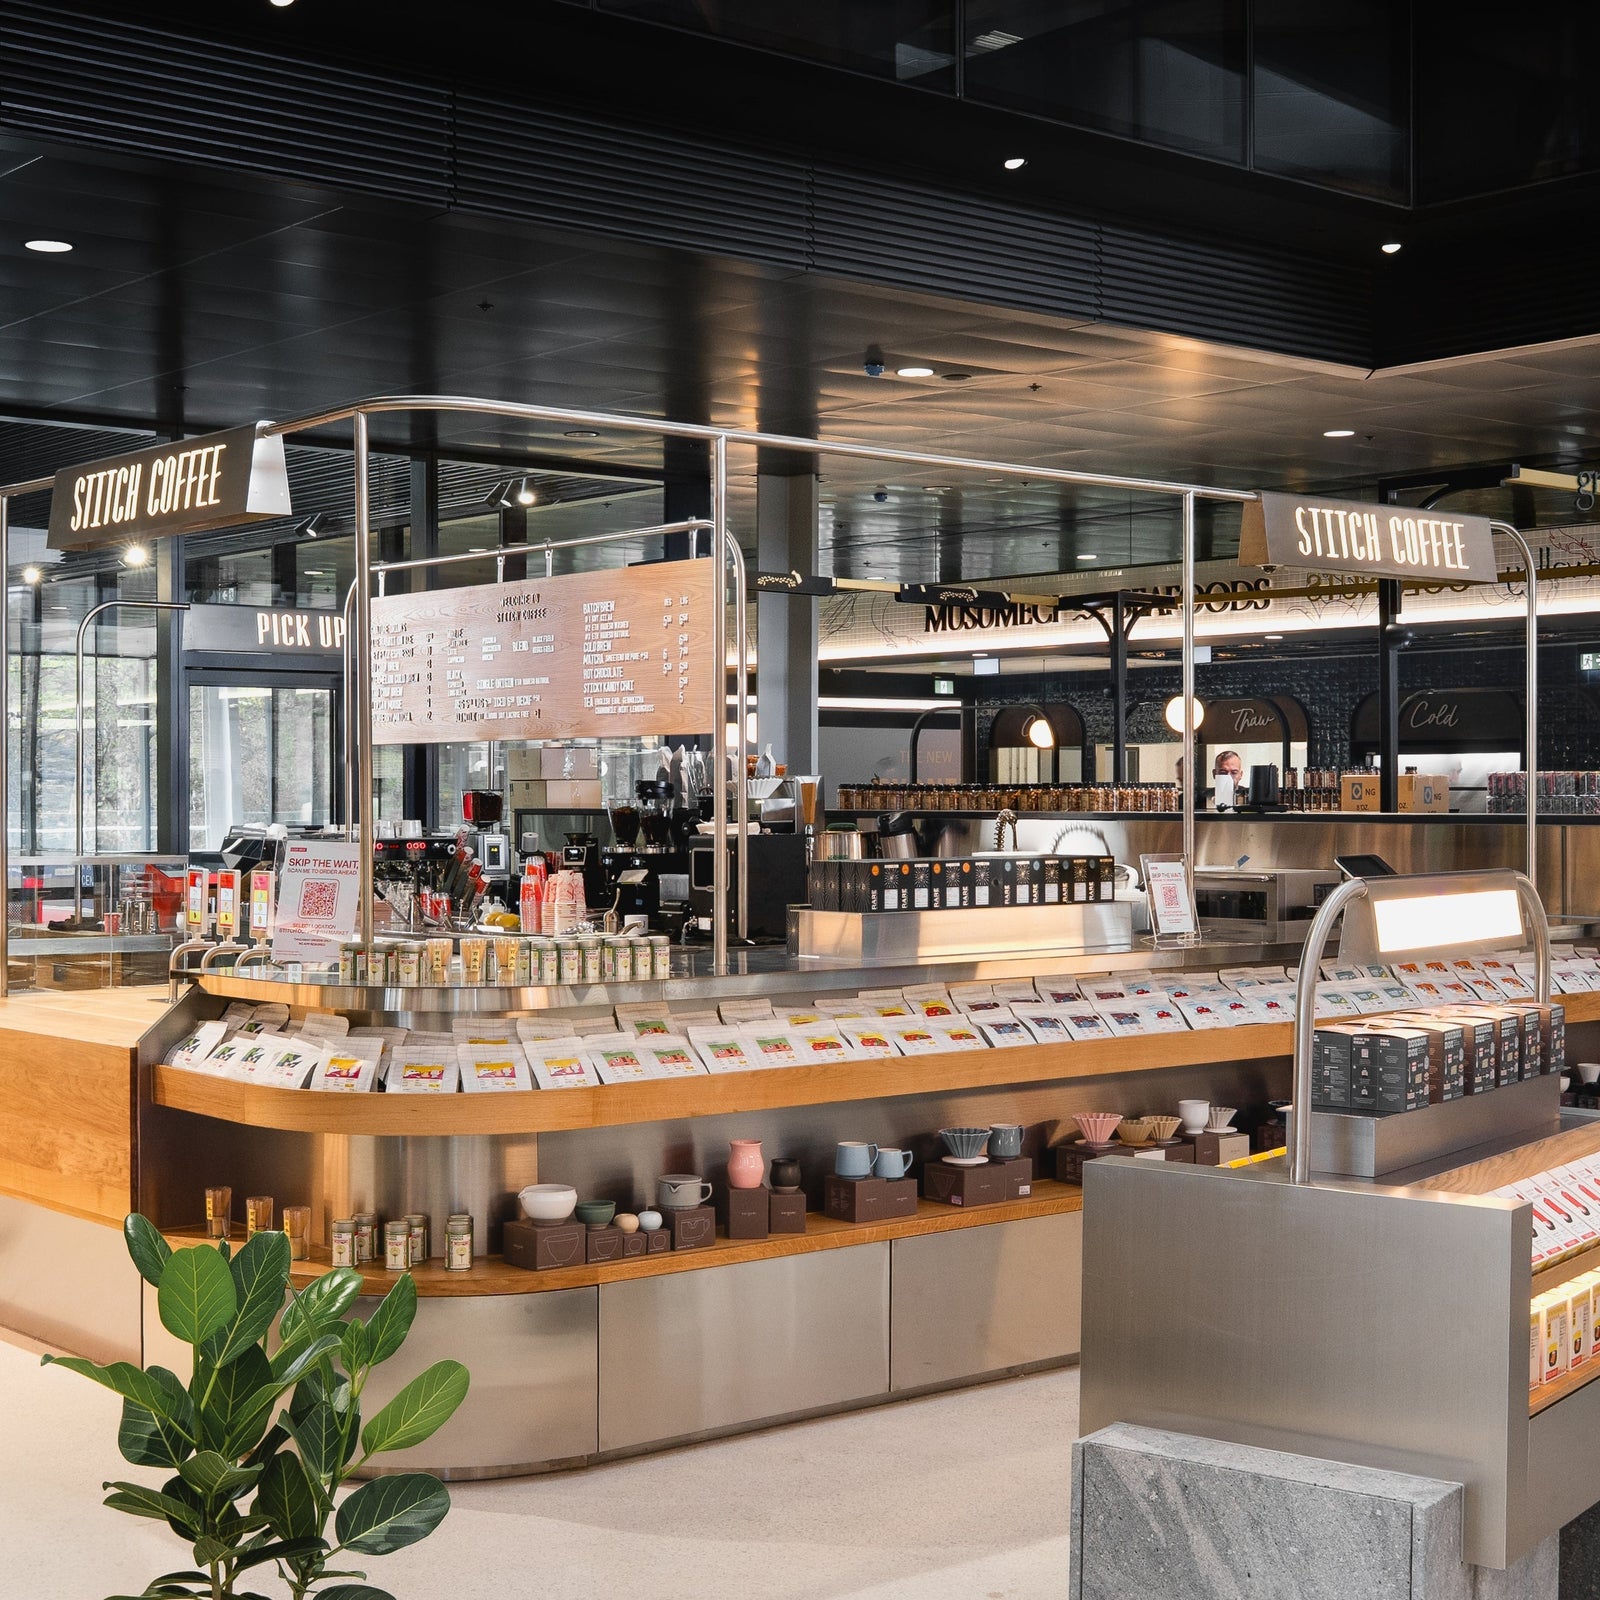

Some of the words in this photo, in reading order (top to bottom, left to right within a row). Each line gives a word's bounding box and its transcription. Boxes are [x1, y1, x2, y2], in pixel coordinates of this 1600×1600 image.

[70, 463, 142, 532] STITCH
[147, 444, 227, 516] COFFEE
[1295, 506, 1381, 561] STITCH
[1389, 516, 1470, 569] COFFEE
[257, 612, 310, 647] PICK
[318, 616, 345, 648] UP
[594, 666, 624, 678] CHOCOLATE
[1231, 708, 1275, 733] Thaw
[1410, 701, 1459, 728] Cold
[926, 751, 953, 763] NEW
[1365, 788, 1376, 796] NG
[289, 858, 311, 867] SKIP
[312, 859, 331, 868] THE
[962, 886, 970, 906] RARE
